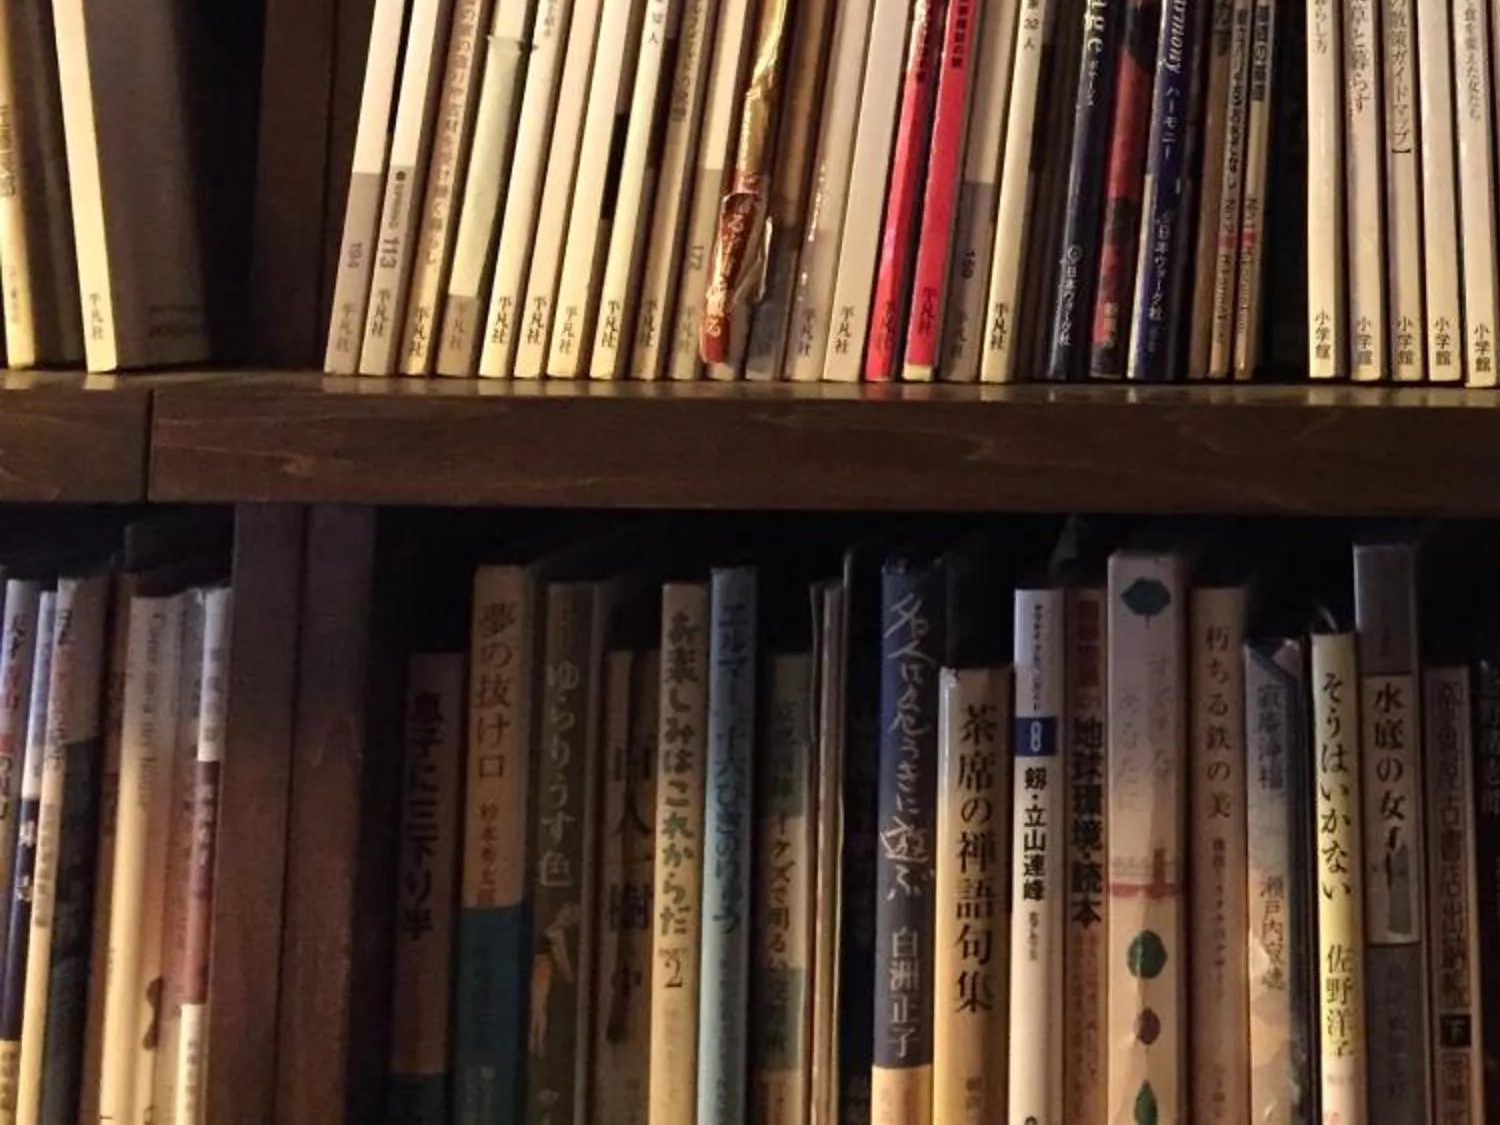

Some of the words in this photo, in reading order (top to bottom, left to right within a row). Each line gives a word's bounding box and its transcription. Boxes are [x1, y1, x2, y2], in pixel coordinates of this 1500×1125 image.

[1314, 309, 1332, 361] 小学館
[1433, 315, 1453, 367] 小学館
[1473, 323, 1493, 374] 小学館
[476, 601, 518, 781] 夢の抜け口
[1204, 623, 1233, 820] 朽ちる鉄の美
[539, 658, 581, 887] ゆらりうす色
[1321, 671, 1353, 900] そうはいかない
[955, 702, 1001, 1015] 茶席の禅語句集
[887, 928, 921, 1059] 白洲正子
[1326, 944, 1356, 1058] 佐野洋子
